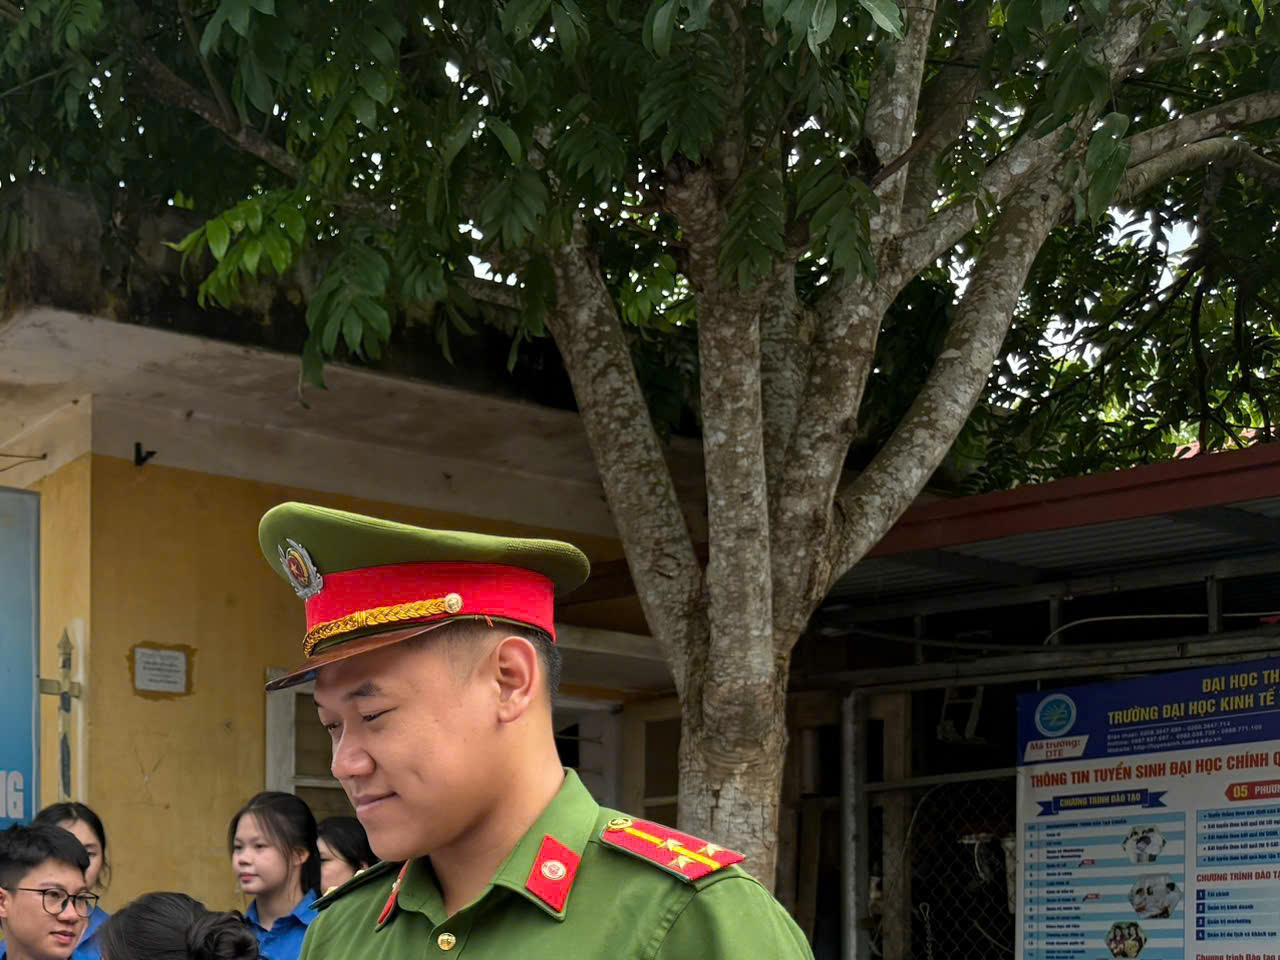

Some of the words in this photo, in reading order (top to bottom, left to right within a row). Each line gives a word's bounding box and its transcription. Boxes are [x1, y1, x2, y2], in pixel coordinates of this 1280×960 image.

[1202, 677, 1225, 694] ĐẠI
[1230, 672, 1258, 690] HỌC
[1108, 705, 1159, 725] TRƯỜNG
[1163, 703, 1184, 720] ĐẠI
[1189, 699, 1216, 717] HỌC
[1220, 694, 1254, 712] KINH
[1258, 686, 1275, 706] TẾ
[1031, 771, 1067, 789] THÔNG
[1071, 771, 1090, 785] TIN
[1094, 760, 1132, 783] TUYỂN
[1136, 763, 1166, 779] SINH
[1170, 760, 1192, 778] ĐẠI
[1196, 757, 1222, 775] HỌC
[1227, 751, 1269, 770] CHÍNH
[1233, 785, 1248, 799] 05
